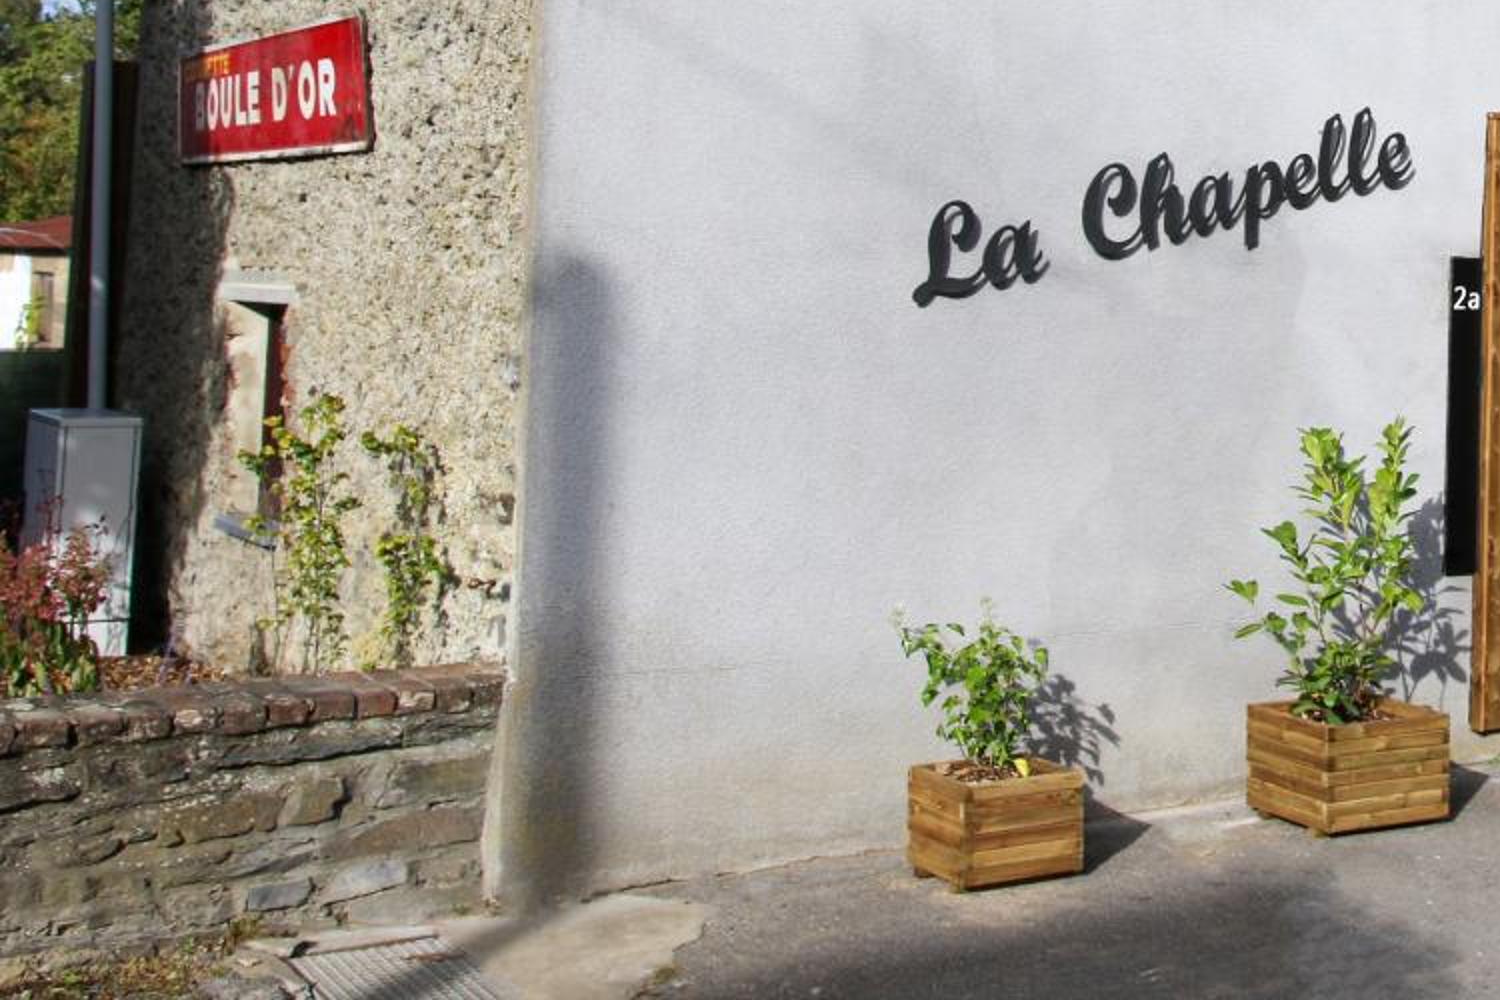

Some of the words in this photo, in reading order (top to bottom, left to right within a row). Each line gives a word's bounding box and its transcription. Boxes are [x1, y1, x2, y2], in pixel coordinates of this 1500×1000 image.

[195, 70, 261, 132] BOULE
[271, 57, 337, 121] D'OR
[912, 199, 1050, 308] La
[1082, 106, 1416, 261] Chapelle
[1453, 285, 1481, 310] 2a
